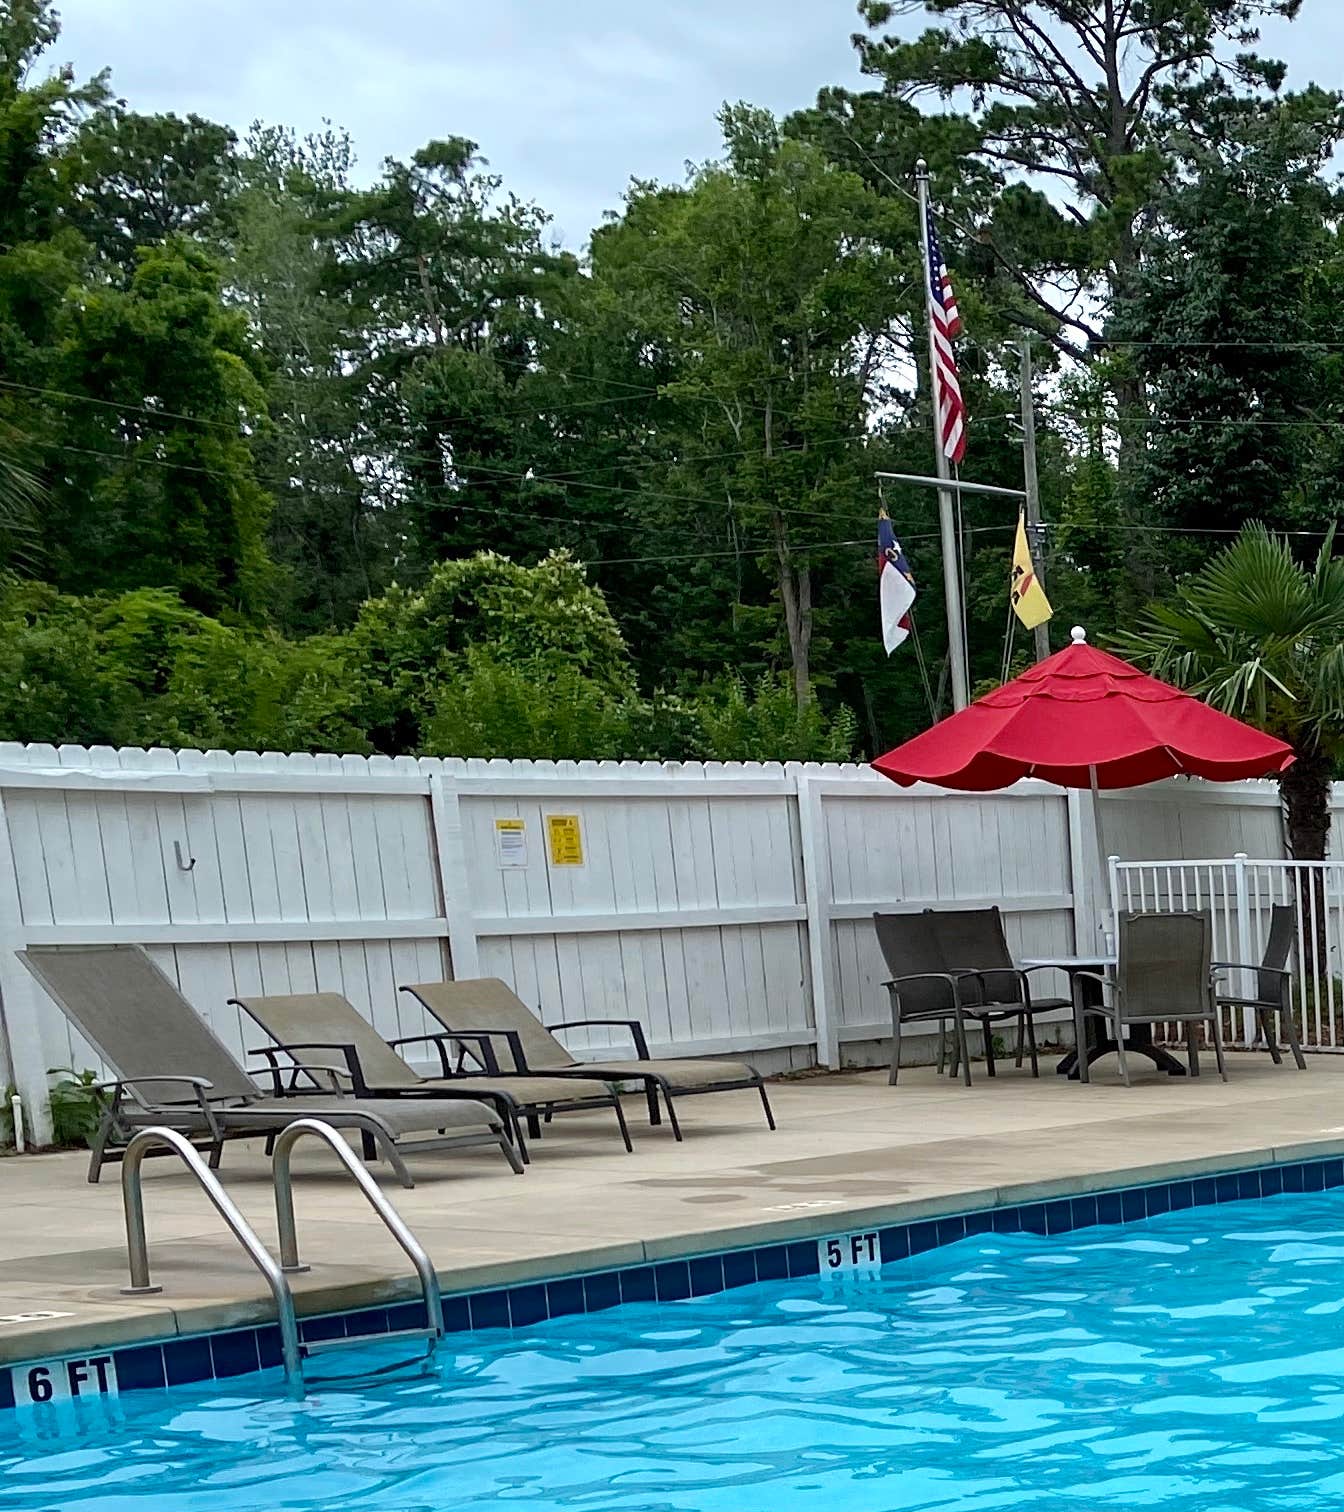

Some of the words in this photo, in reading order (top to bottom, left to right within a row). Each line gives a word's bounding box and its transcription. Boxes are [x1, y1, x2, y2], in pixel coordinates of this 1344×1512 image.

[827, 1239, 842, 1268] 5
[851, 1233, 877, 1265] FT
[28, 1367, 53, 1402] 6
[67, 1356, 111, 1396] FT
